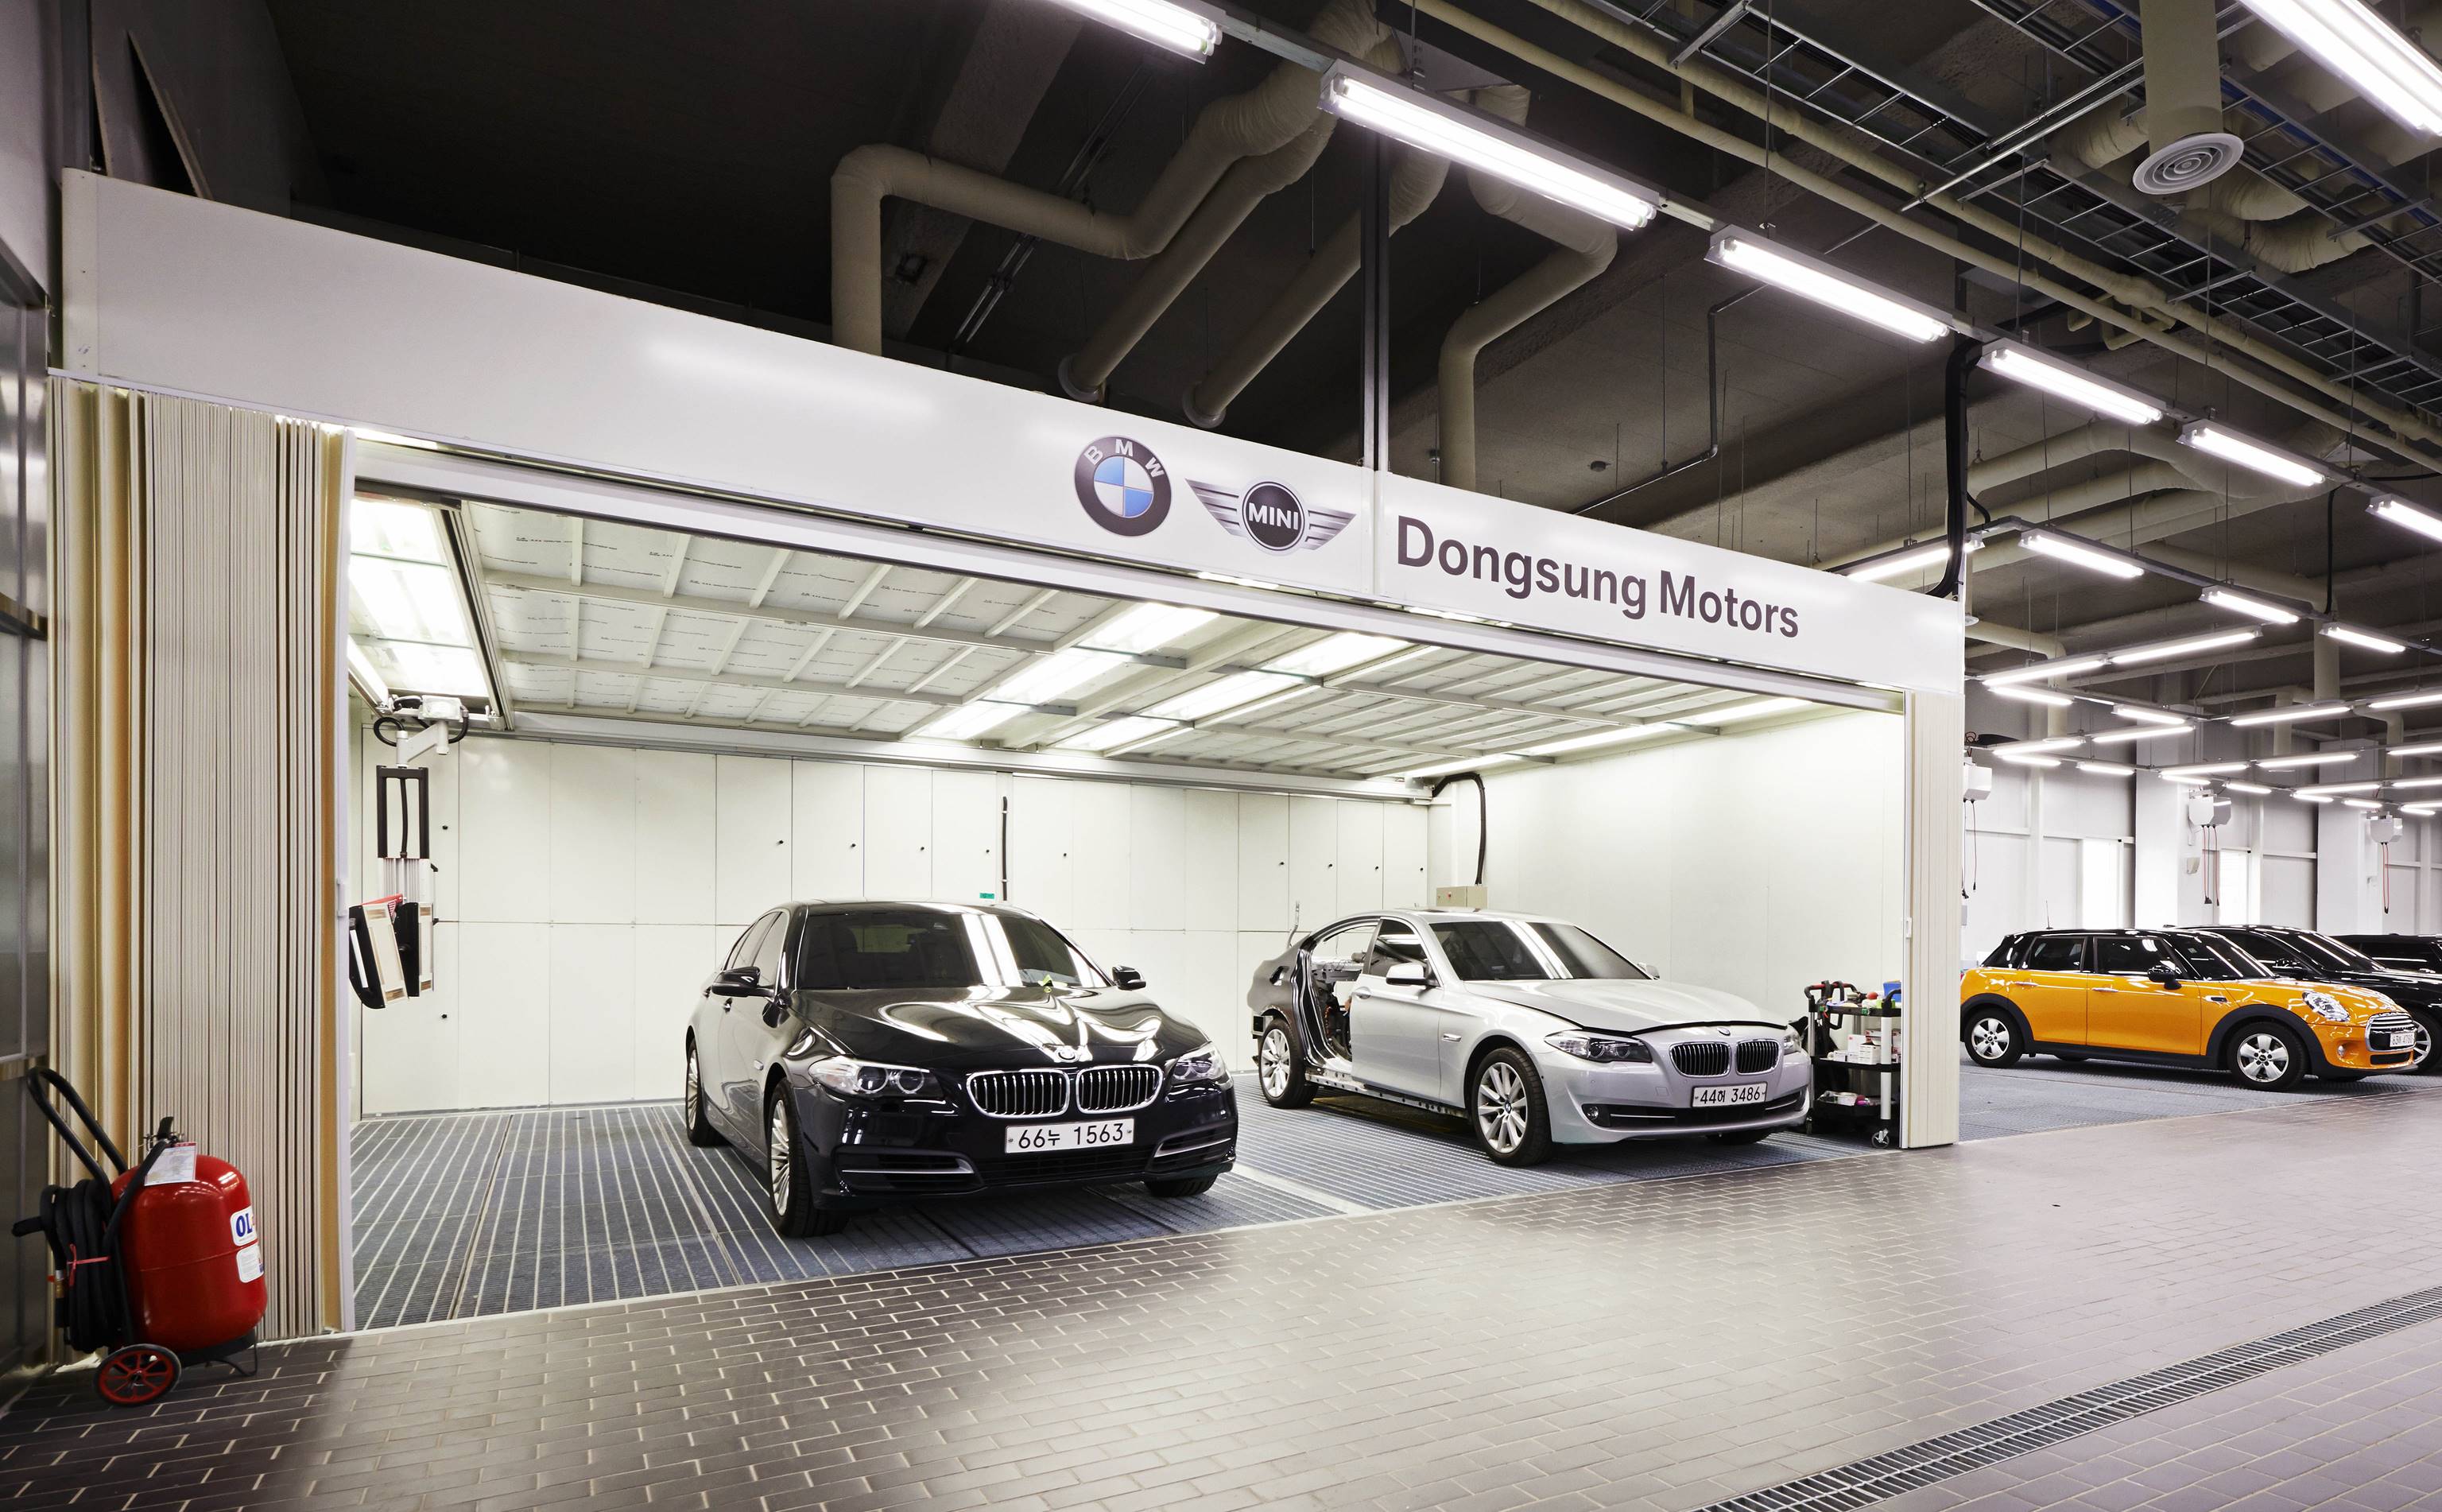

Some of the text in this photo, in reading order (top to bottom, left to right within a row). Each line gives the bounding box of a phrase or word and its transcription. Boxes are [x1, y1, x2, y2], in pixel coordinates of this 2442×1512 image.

[1084, 438, 1165, 479] BMW
[1248, 502, 1299, 530] MINI
[1397, 514, 1799, 638] Dongsung Motors
[1731, 1086, 1761, 1103] 3486
[1018, 1122, 1124, 1150] 66누 1563
